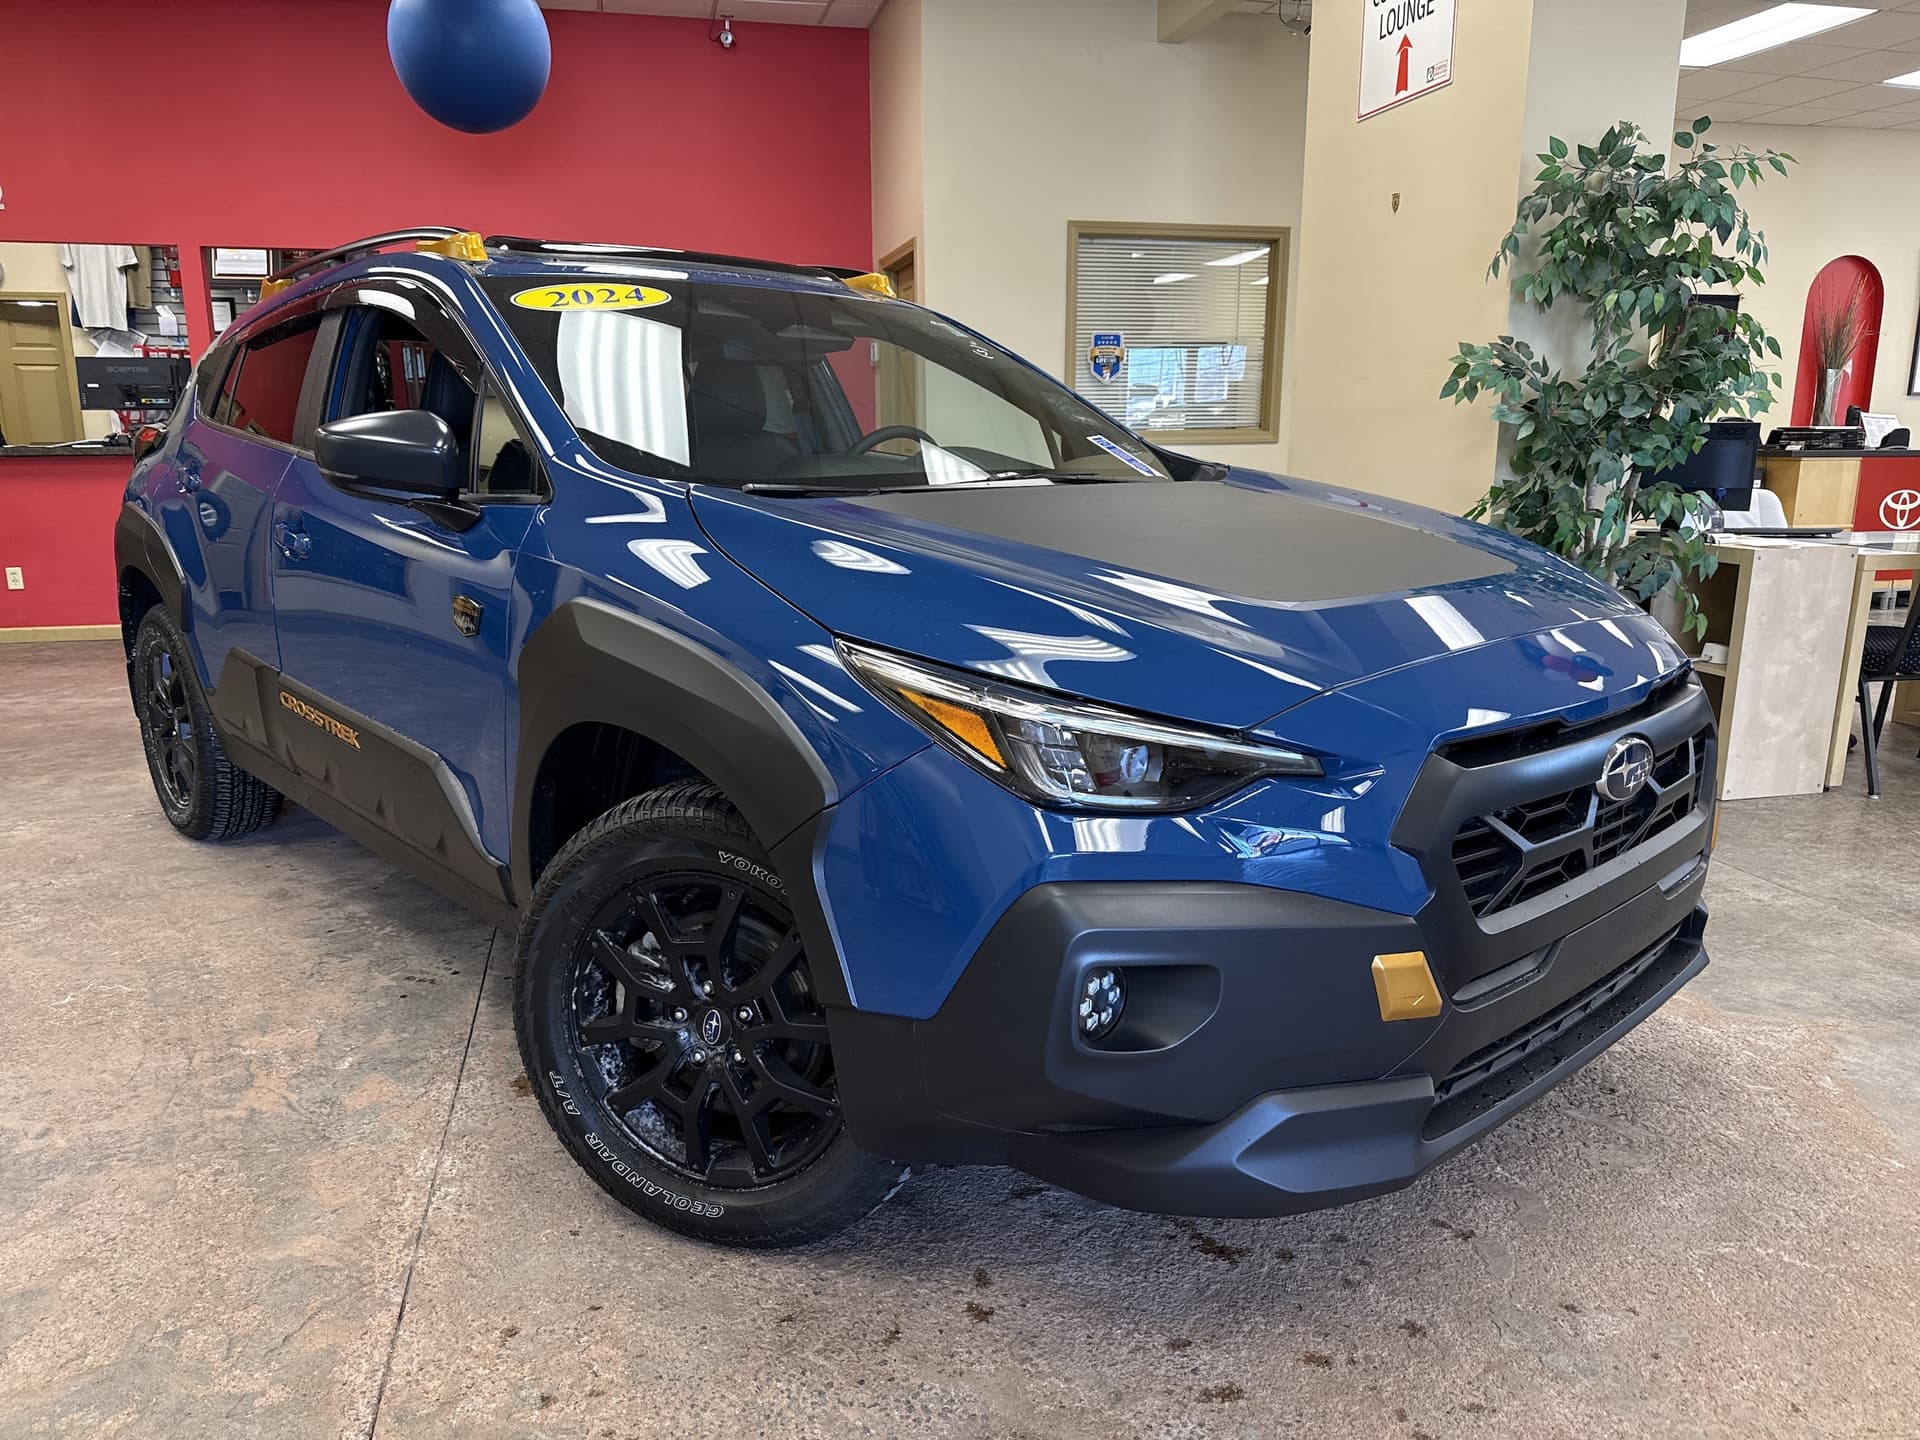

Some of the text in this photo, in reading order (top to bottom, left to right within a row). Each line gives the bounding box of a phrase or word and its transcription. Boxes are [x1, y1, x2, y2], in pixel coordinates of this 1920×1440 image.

[1379, 0, 1435, 40] LOUNGE
[545, 287, 646, 308] 2024
[106, 366, 149, 374] SCEPTRE
[1718, 426, 1752, 436] acer
[280, 691, 361, 750] CROSSTREK
[718, 851, 788, 896] YOKO
[549, 1071, 725, 1218] GEOLANDAR A/T
